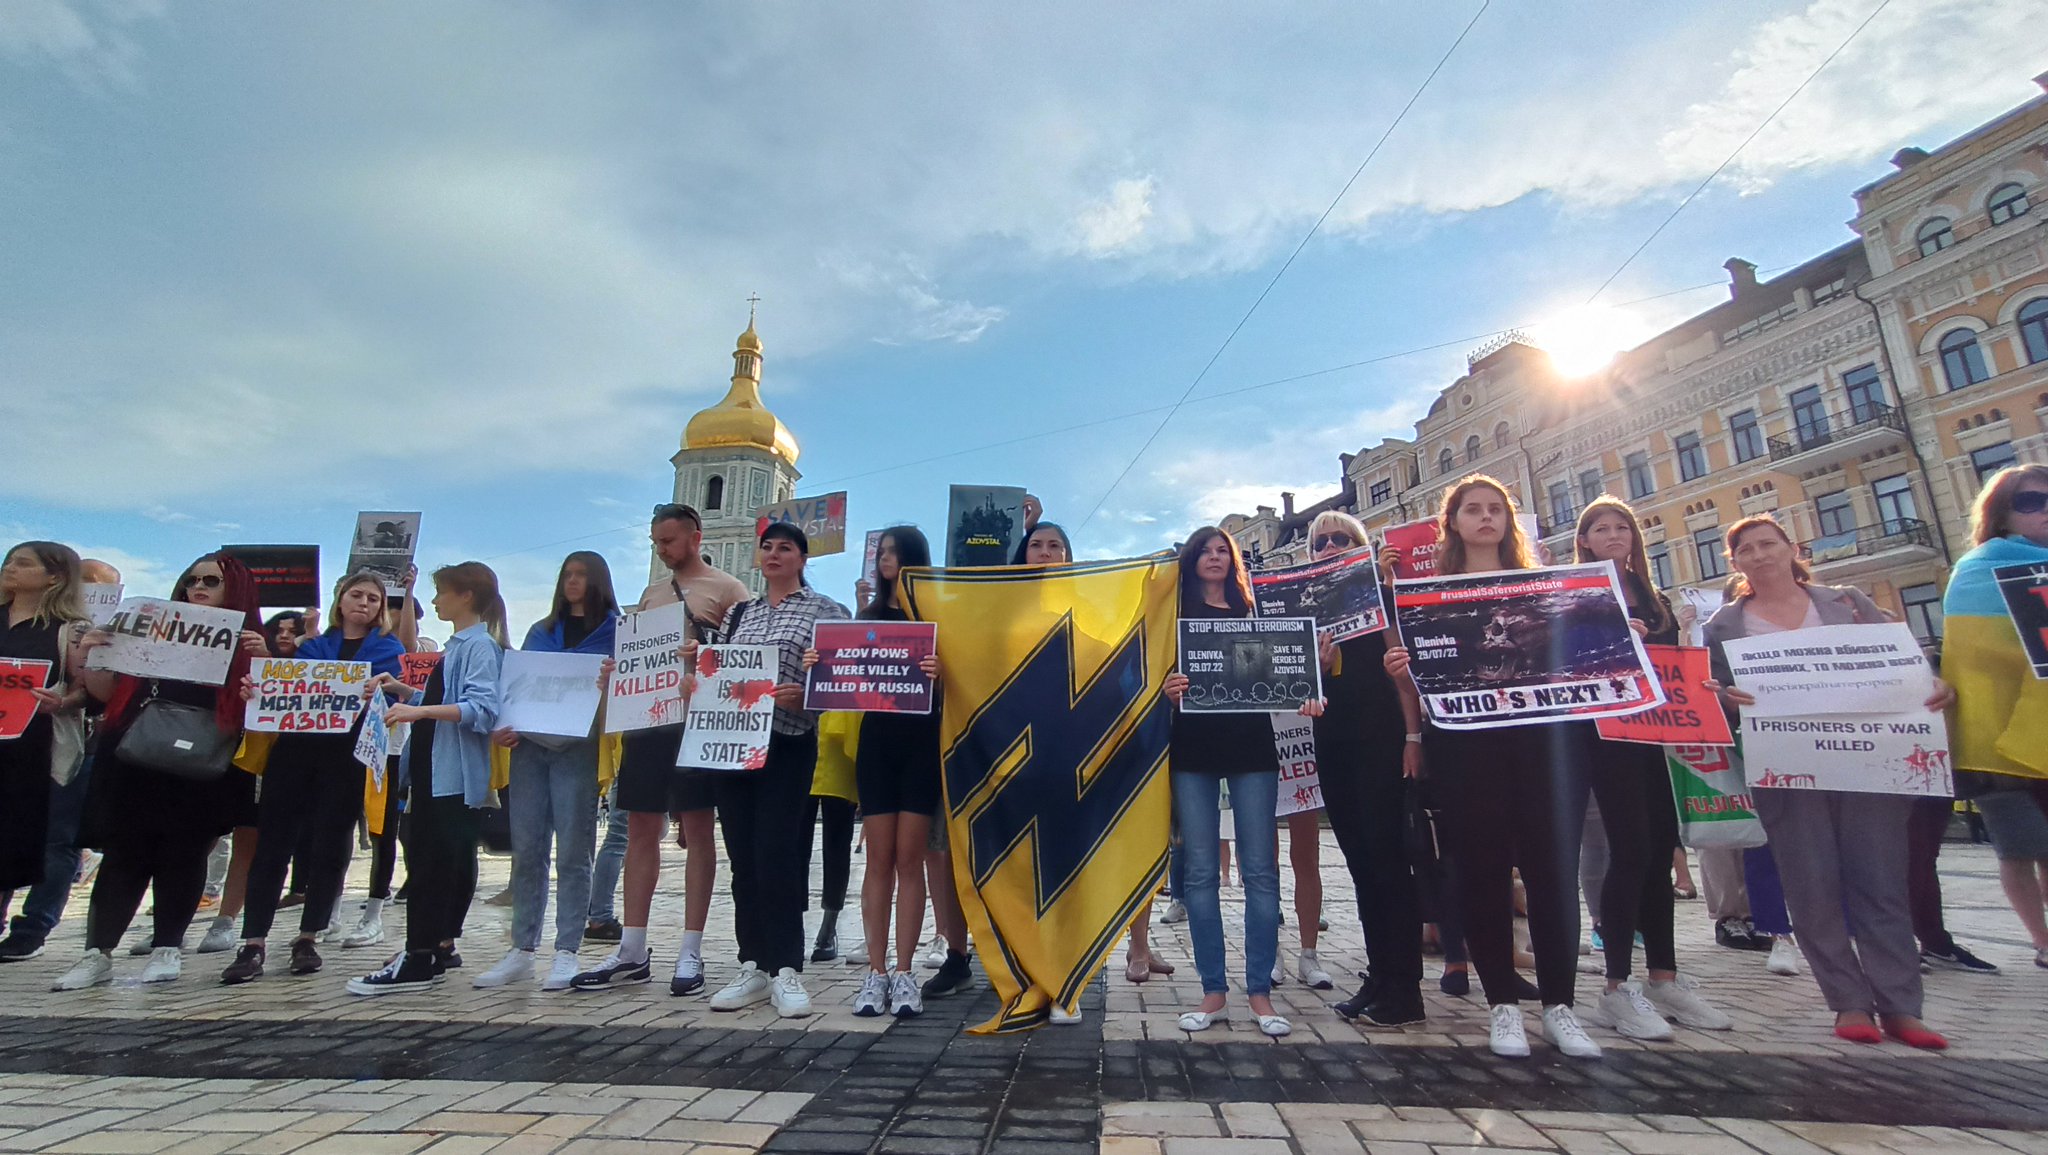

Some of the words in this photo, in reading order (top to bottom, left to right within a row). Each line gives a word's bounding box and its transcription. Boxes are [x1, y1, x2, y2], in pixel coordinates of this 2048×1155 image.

[768, 500, 826, 522] SAVE
[1189, 622, 1212, 633] STOP
[1214, 621, 1253, 633] RUSSIAN
[1254, 621, 1305, 632] TERRORISM
[621, 632, 680, 653] PRISONERS
[1414, 635, 1456, 648] Olenivka
[835, 648, 869, 659] AZOV
[871, 648, 909, 659] POWS
[1188, 651, 1224, 660] OLENIVKA
[1273, 645, 1290, 653] SAVE
[1292, 645, 1303, 654] THE
[1417, 647, 1458, 660] 29/07/22
[618, 656, 640, 675] OF
[644, 649, 679, 670] WAR
[713, 649, 763, 670] RUSSIA
[1272, 656, 1297, 664] HEROES
[1297, 656, 1306, 664] OF
[312, 661, 367, 684] СЕРЦЕ
[832, 665, 865, 676] WERE
[867, 665, 910, 676] VILELY
[1189, 662, 1223, 672] 29.07.22
[1274, 666, 1306, 674] AZOVSTAL
[614, 670, 680, 697] KILLED
[718, 679, 731, 699] IS
[815, 682, 856, 692] KILLED
[859, 682, 876, 693] BY
[878, 682, 924, 694] RUSSIA
[1532, 683, 1602, 707] NEXT
[259, 695, 302, 712] МОЯ
[689, 710, 771, 732] TERRORIST
[1761, 721, 1856, 734] PRISONERS
[1861, 723, 1883, 734] OF
[1888, 723, 1931, 735] WAR
[1815, 739, 1875, 751] KILLED
[700, 742, 748, 764] STATE
